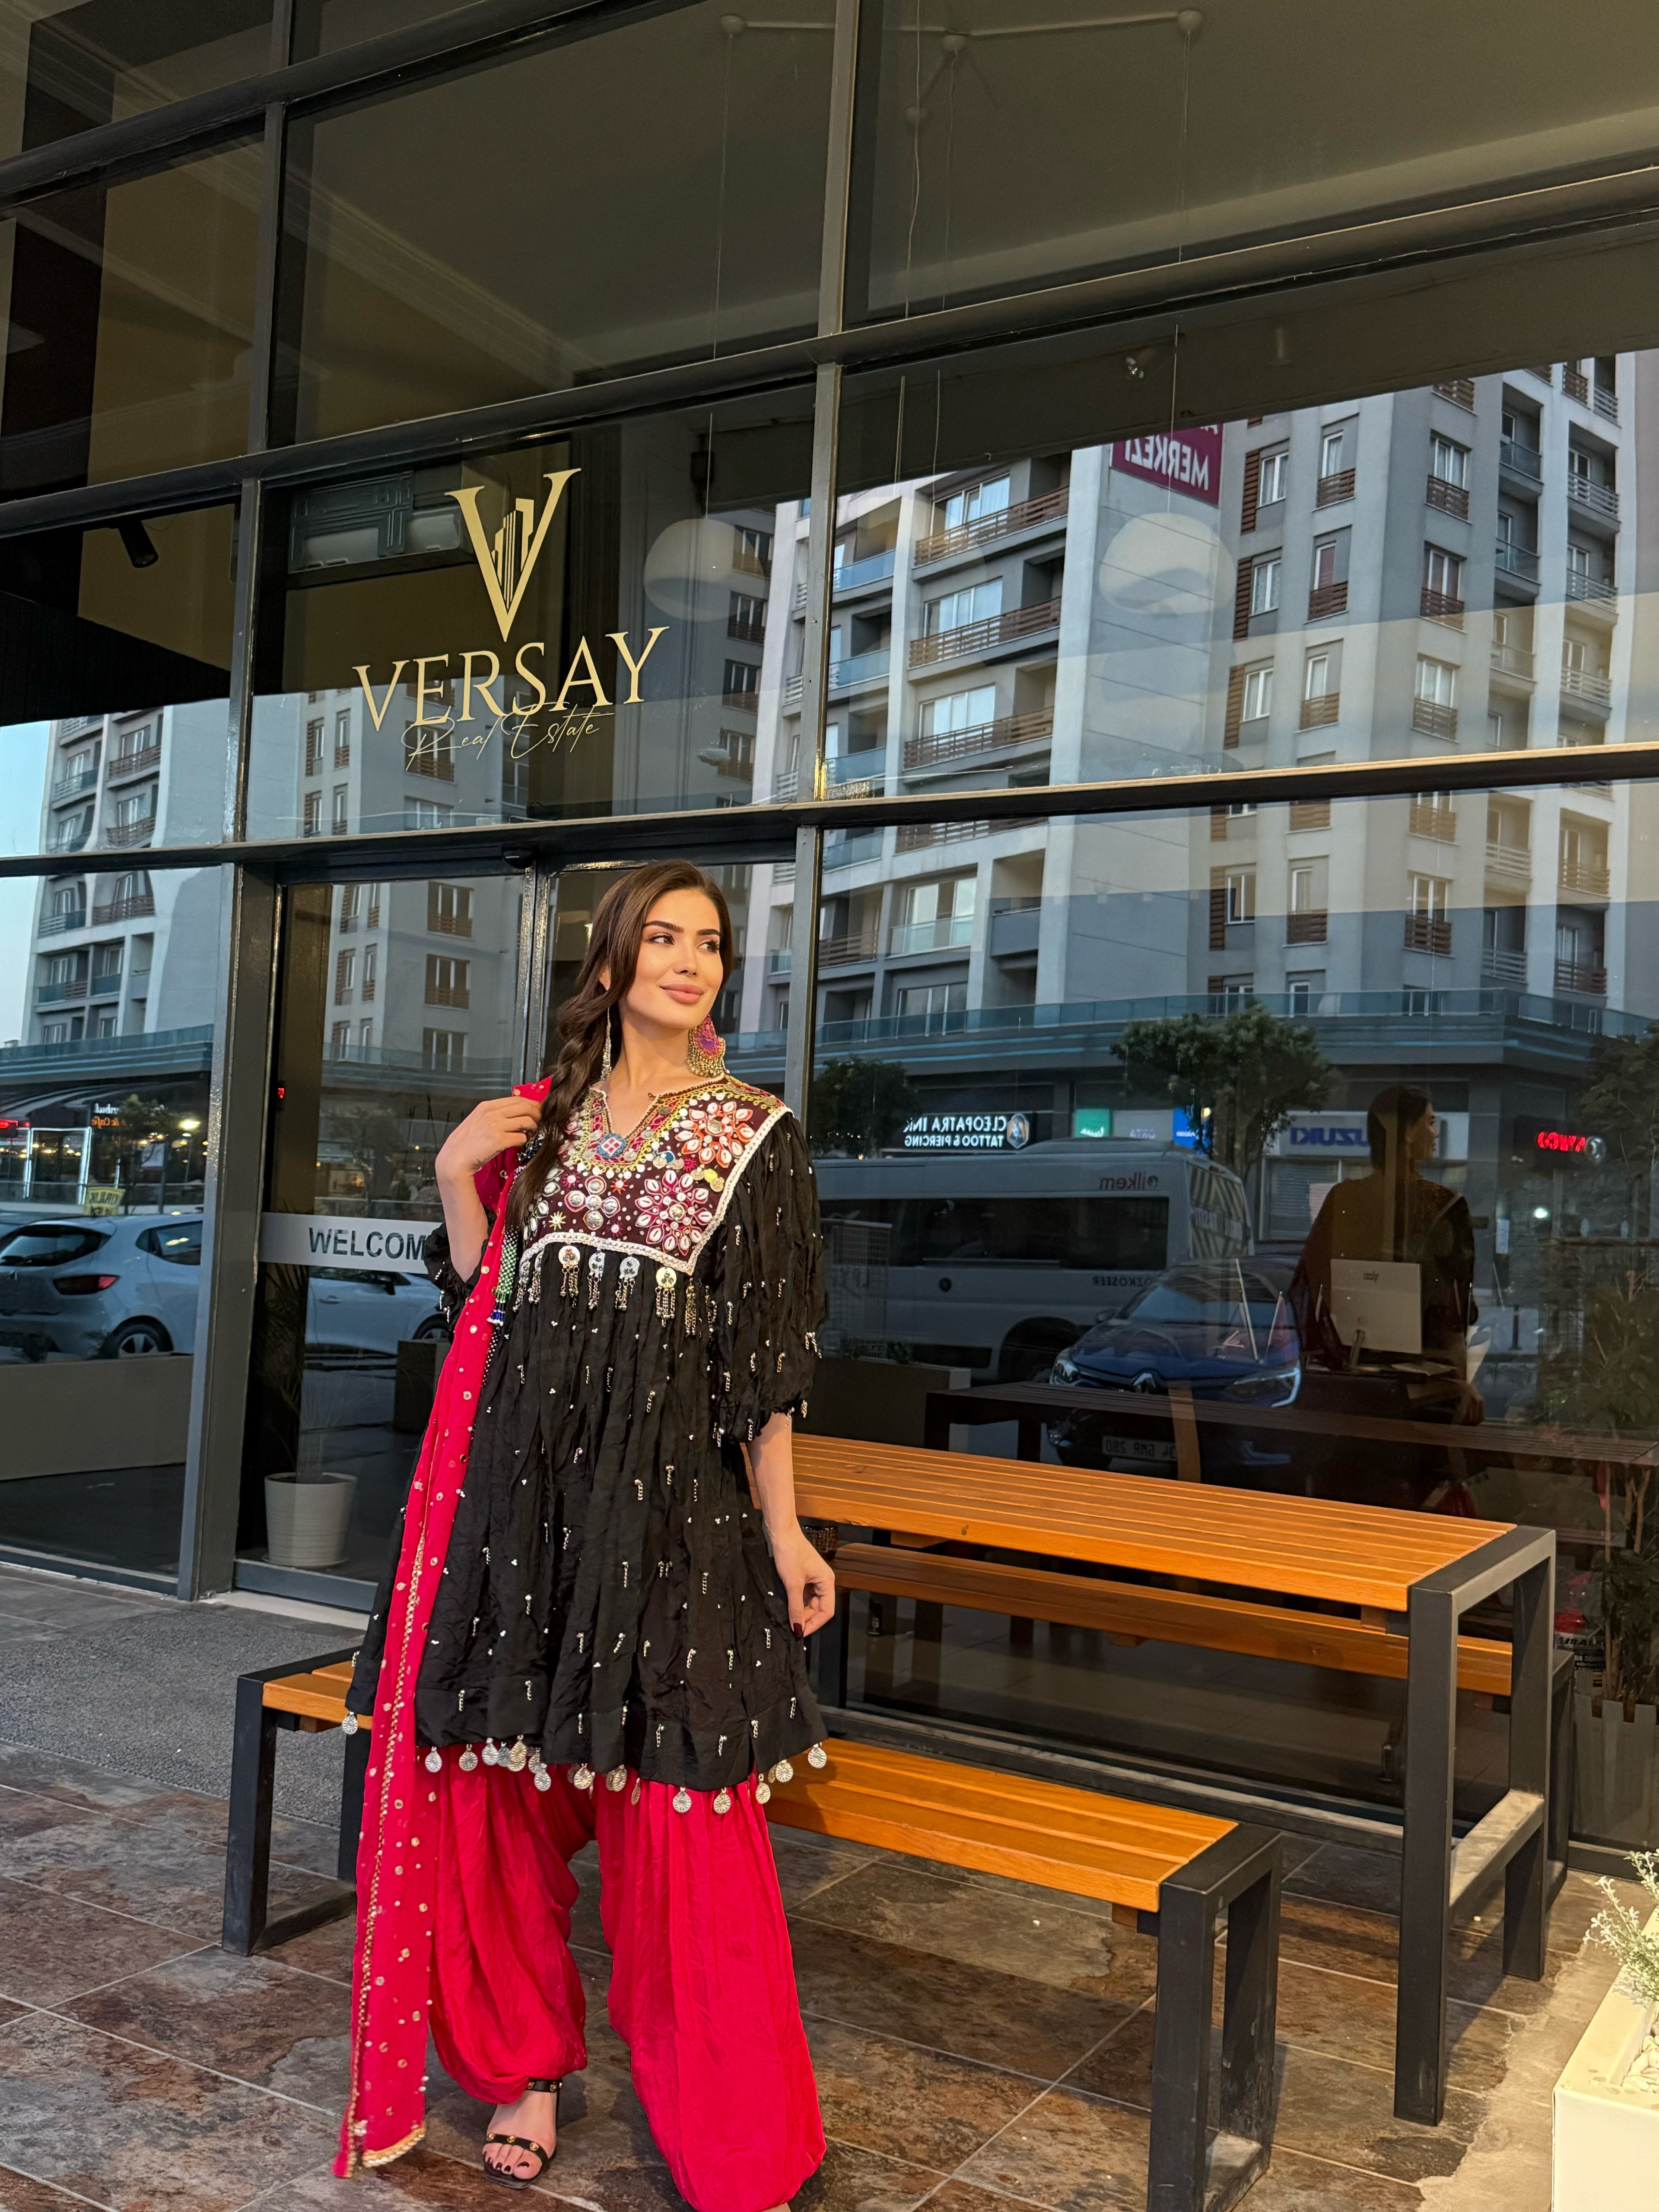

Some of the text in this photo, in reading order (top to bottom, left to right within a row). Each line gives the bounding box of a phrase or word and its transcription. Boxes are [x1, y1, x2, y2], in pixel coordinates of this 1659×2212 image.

[353, 626, 670, 732] VERSAY
[401, 702, 616, 772] Real Estate
[308, 1227, 427, 1261] WELCOM
